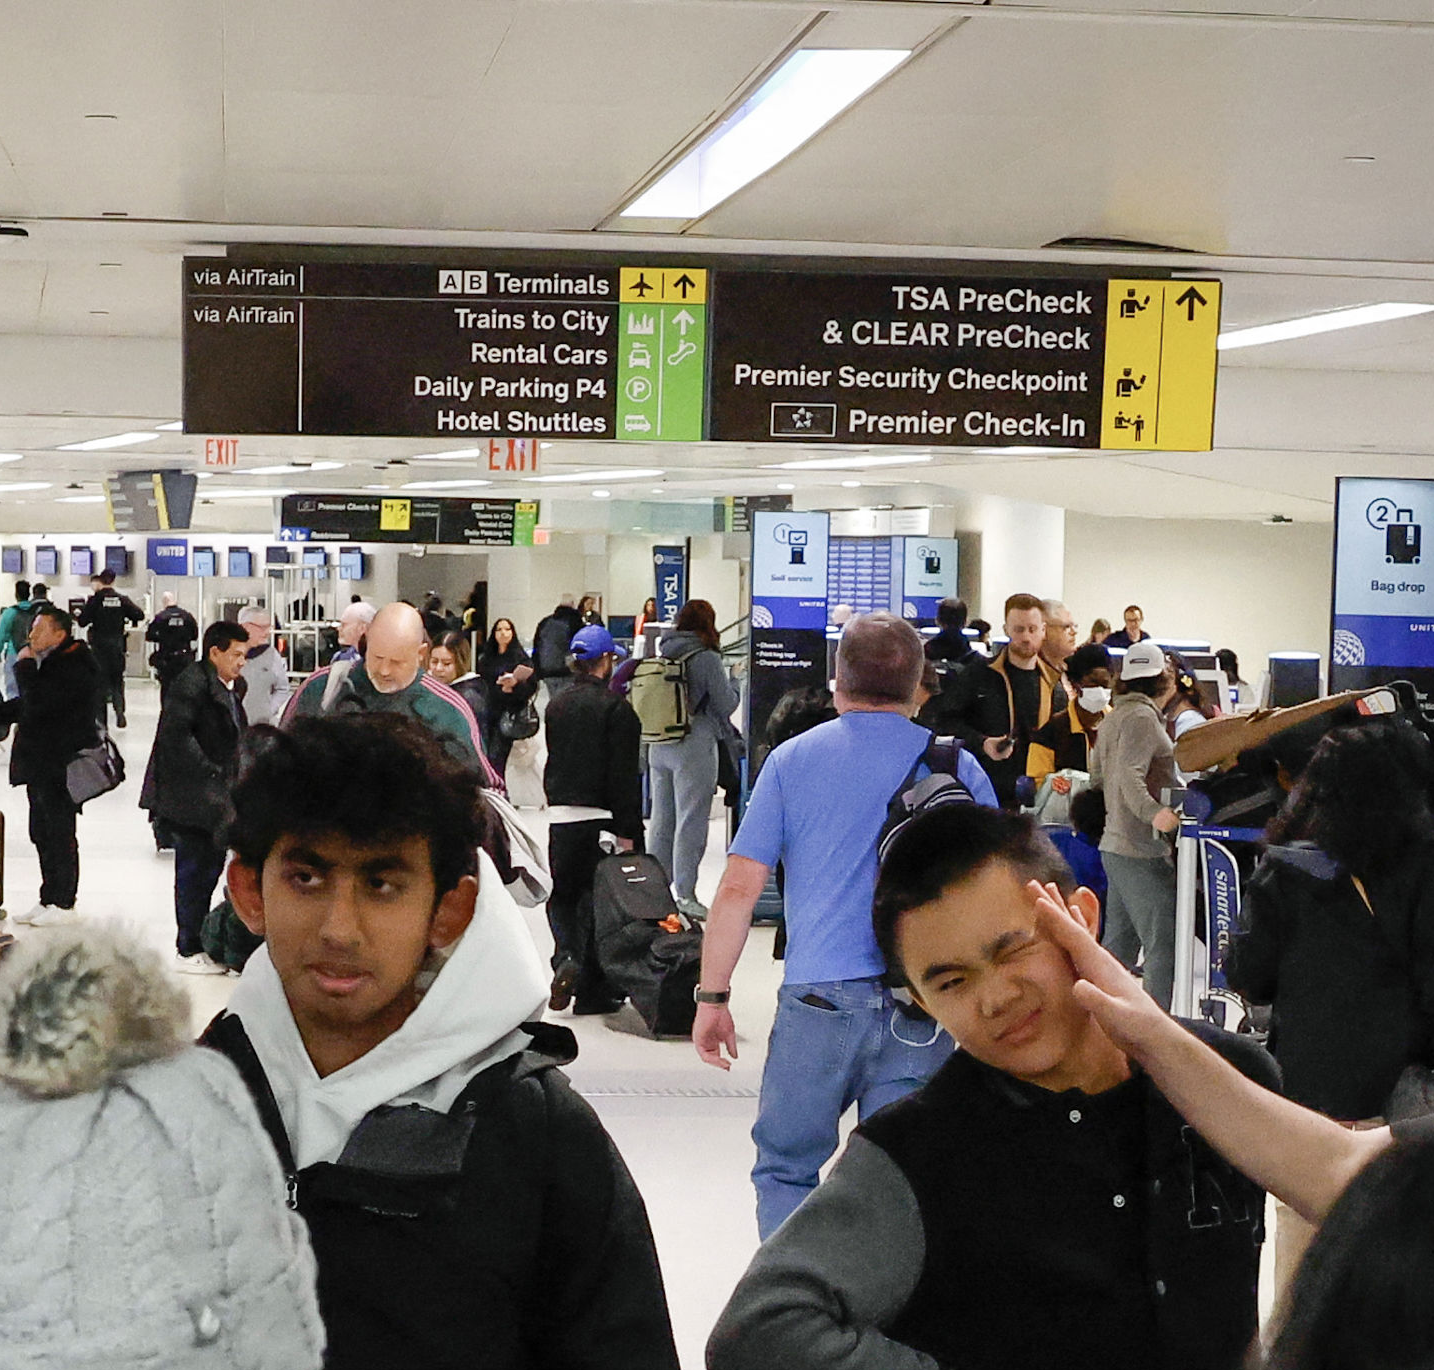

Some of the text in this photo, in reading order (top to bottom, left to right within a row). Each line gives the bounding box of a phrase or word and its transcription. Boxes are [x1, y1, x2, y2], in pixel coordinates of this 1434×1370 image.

[193, 268, 296, 287] via AirTrain
[493, 272, 611, 296] Terminals
[891, 286, 1093, 315] TSA PreCheck
[193, 305, 295, 324] via AirTrain
[453, 307, 611, 336] Trains to City
[822, 319, 1091, 351] & CLEAR PreCheck
[471, 342, 609, 366] Rental Cars
[414, 375, 607, 404] Daily Parking P4
[734, 363, 1089, 396] Premier Security Checkpoint
[436, 409, 607, 433] Hotel Shuttles
[848, 408, 1087, 438] Premier Check-In
[204, 439, 239, 465] EXIT
[1376, 505, 1388, 522] 2
[156, 546, 186, 557] UNITED
[664, 573, 679, 603] TSA
[1370, 580, 1426, 594] Bag drop
